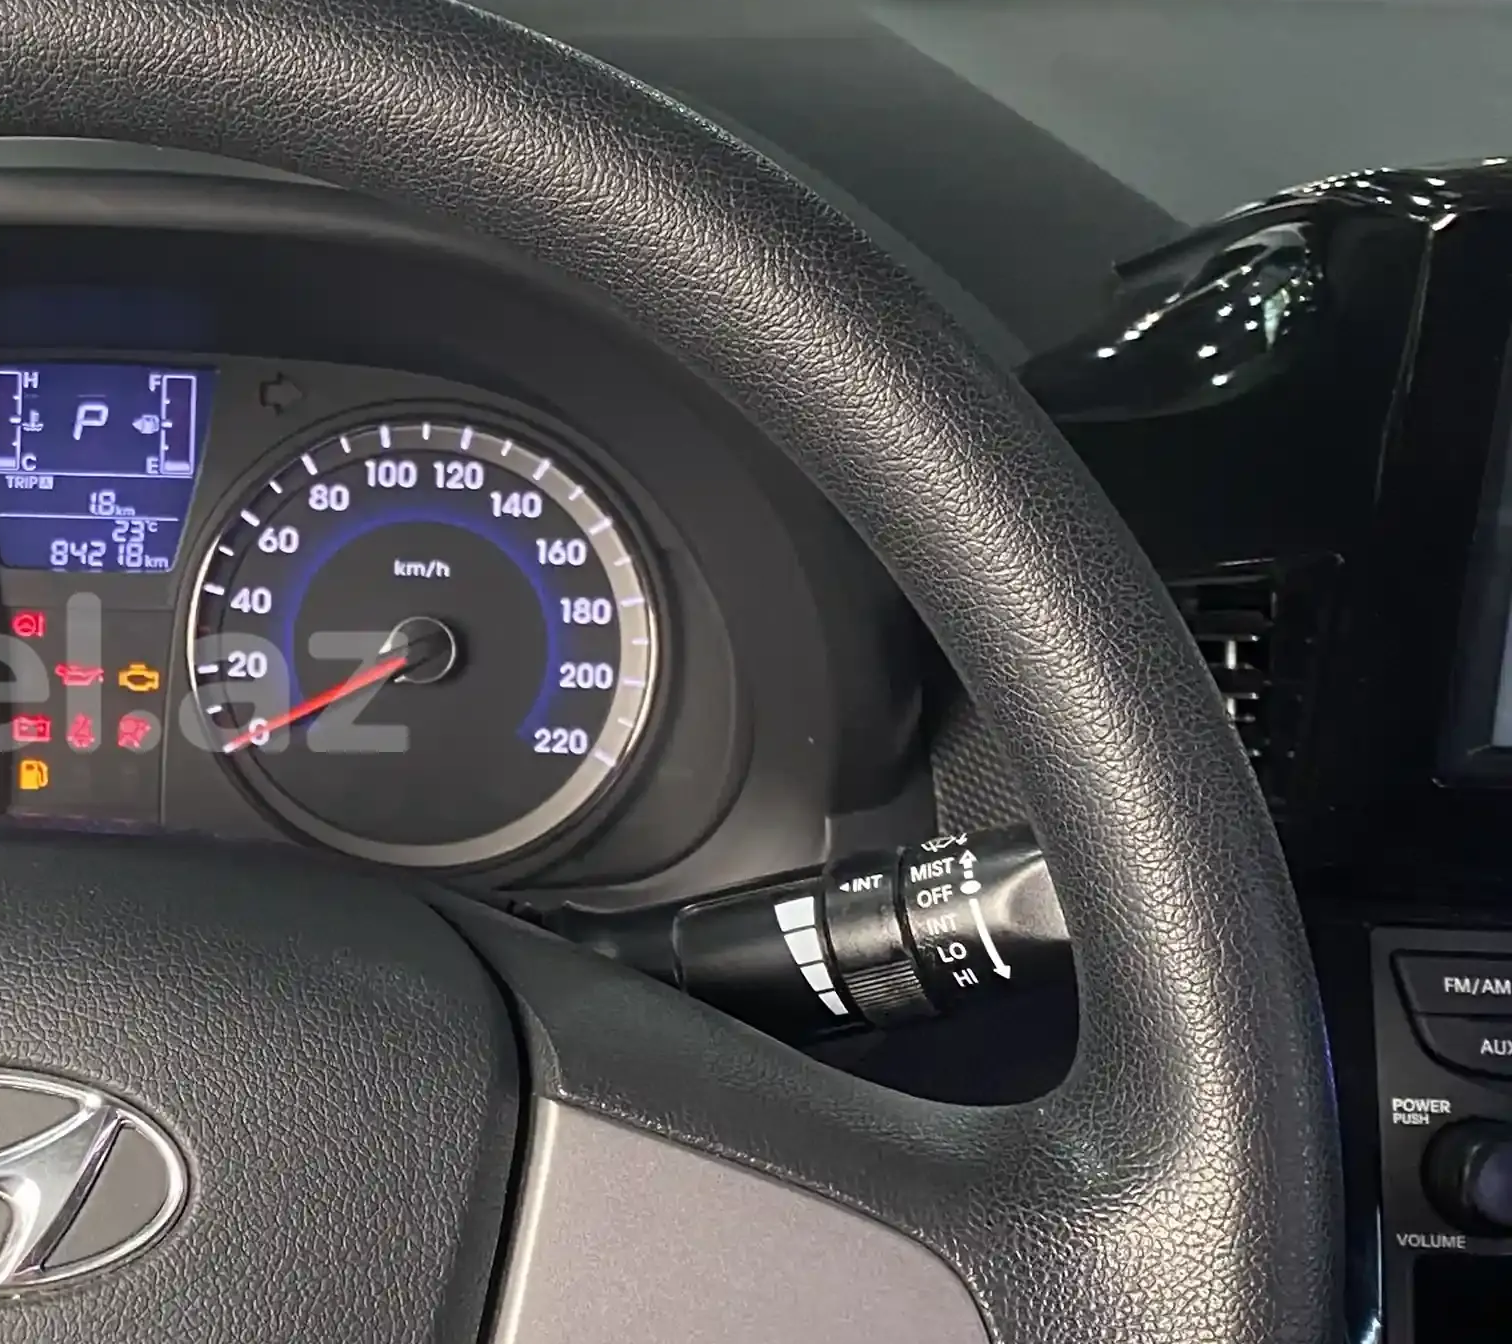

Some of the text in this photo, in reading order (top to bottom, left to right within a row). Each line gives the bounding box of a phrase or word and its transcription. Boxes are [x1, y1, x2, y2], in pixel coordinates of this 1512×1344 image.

[23, 372, 39, 389] H
[148, 374, 162, 392] F
[73, 402, 109, 440] P
[21, 453, 37, 471] C
[146, 457, 159, 474] E
[365, 460, 417, 488] 100
[433, 461, 485, 490] 120
[308, 484, 350, 511] 80
[490, 491, 542, 518] 140
[258, 527, 300, 554] 60
[536, 539, 587, 566] 160
[394, 560, 450, 578] km/h
[230, 587, 272, 614] 40
[560, 597, 612, 625] 180
[228, 651, 267, 678] 20
[559, 662, 613, 689] 200
[249, 718, 270, 746] 0
[534, 728, 587, 754] 220
[910, 857, 955, 883] MIST
[852, 873, 884, 893] INT
[917, 885, 954, 910] OFF
[925, 915, 957, 936] INT
[936, 941, 967, 964] LO
[952, 967, 980, 989] HI
[1444, 977, 1511, 995] FM/AM
[1392, 1098, 1451, 1114] POWER
[1393, 1112, 1429, 1125] PUSH
[1396, 1233, 1467, 1249] VOLUME
